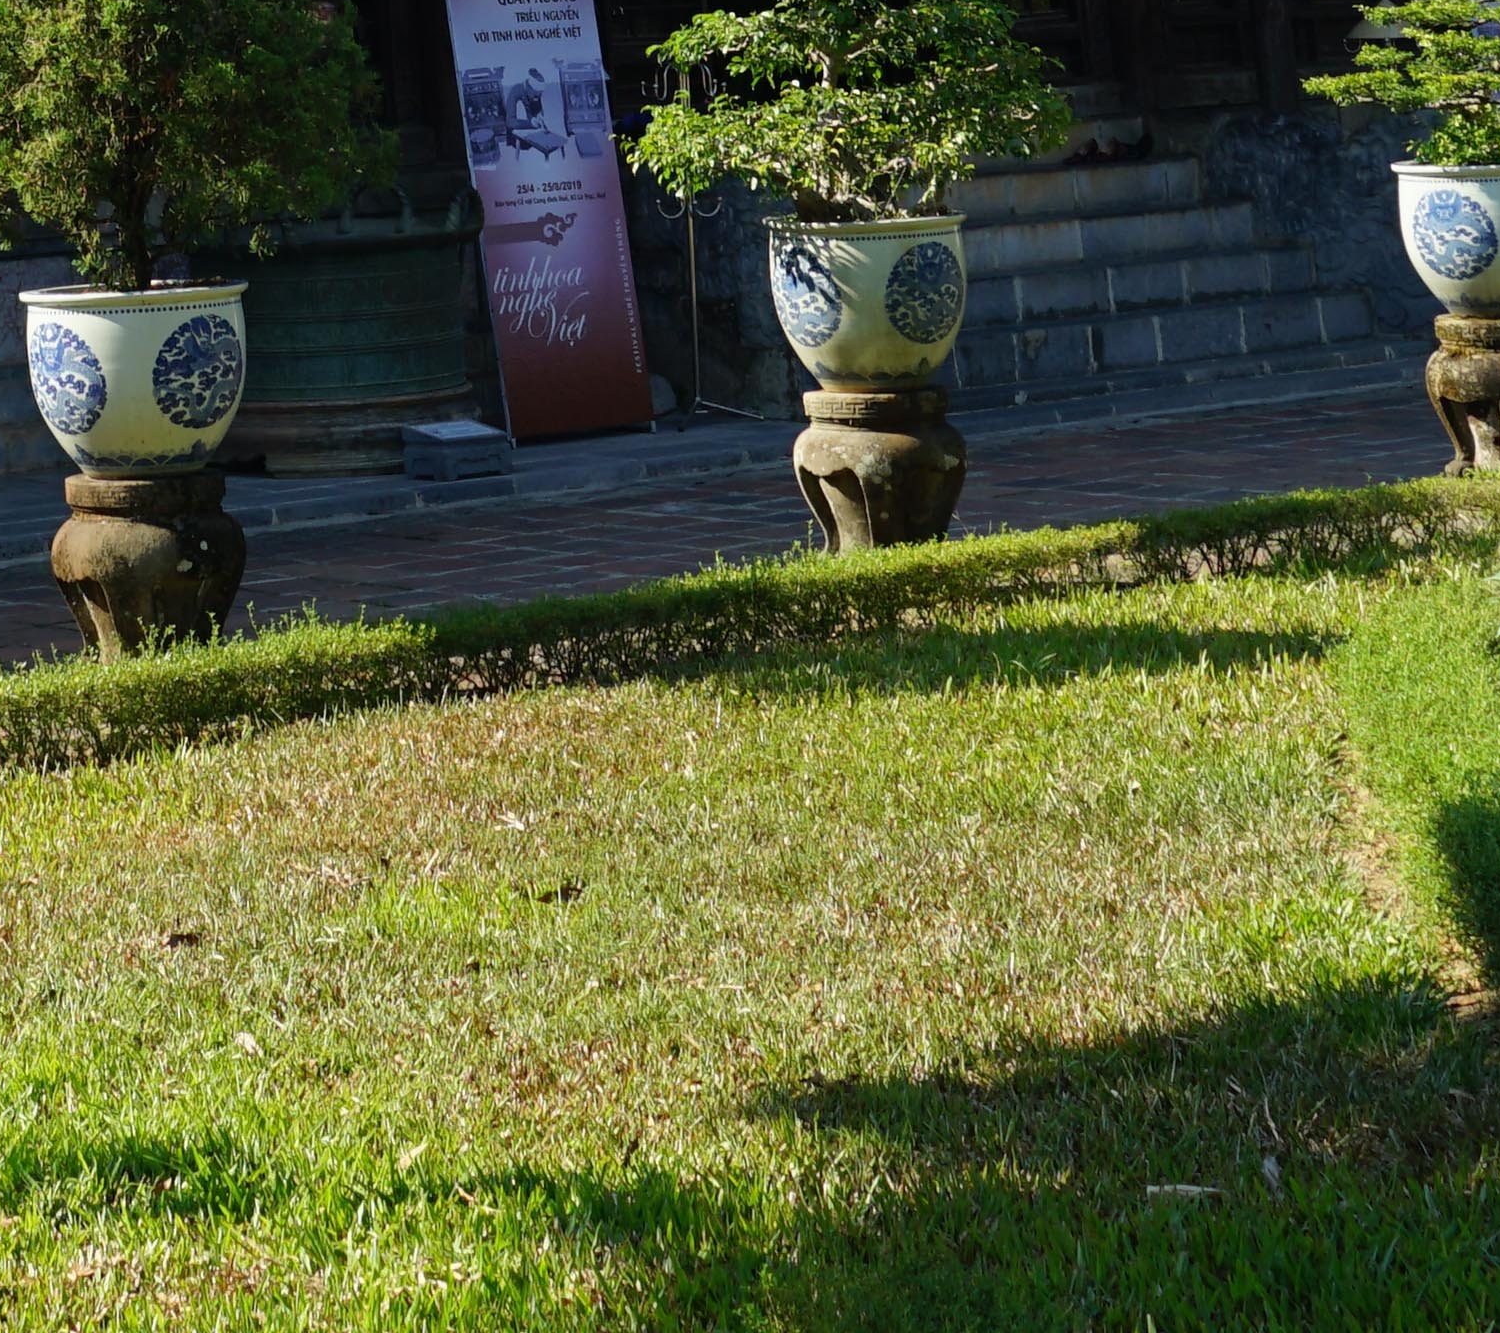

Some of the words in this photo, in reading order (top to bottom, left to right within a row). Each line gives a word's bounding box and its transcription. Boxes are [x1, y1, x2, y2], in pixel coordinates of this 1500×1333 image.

[491, 30, 512, 42] TINH
[513, 28, 534, 41] HOA
[517, 184, 535, 194] 25/4
[539, 254, 583, 290] hoa
